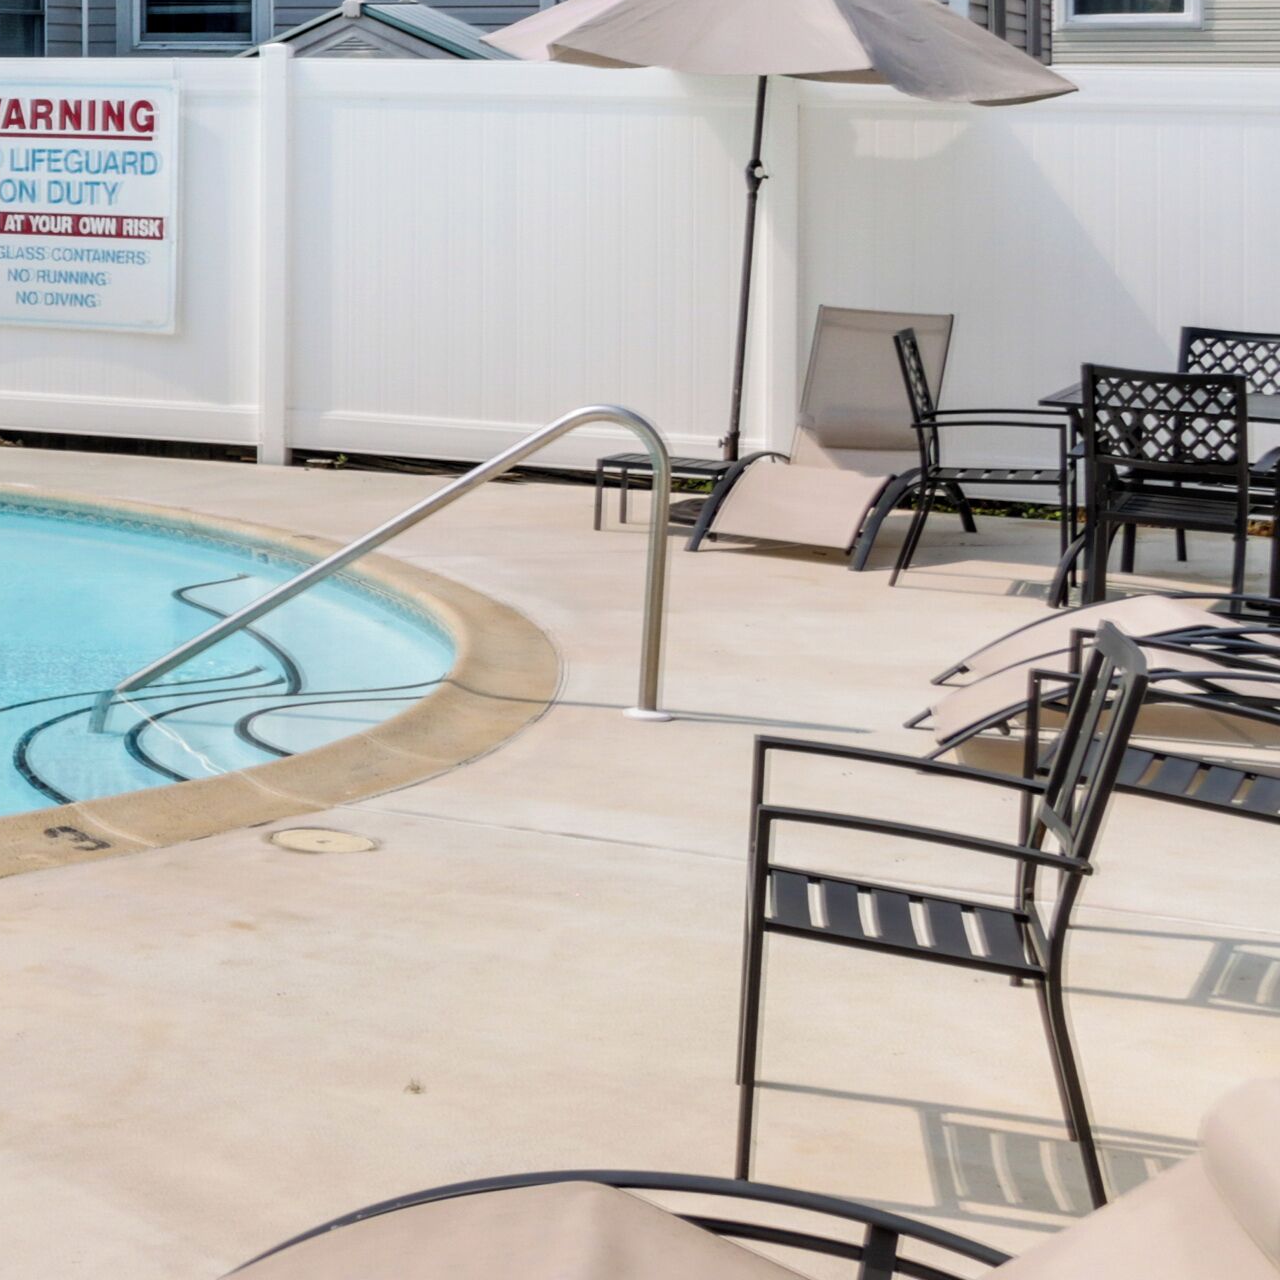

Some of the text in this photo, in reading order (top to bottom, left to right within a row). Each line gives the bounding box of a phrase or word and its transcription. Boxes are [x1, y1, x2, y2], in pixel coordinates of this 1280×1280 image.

[9, 148, 158, 175] LIFEGUARD
[47, 180, 120, 205] DUTY
[4, 214, 25, 232] AT
[28, 215, 72, 234] YOUR
[79, 217, 116, 236] OWN
[122, 218, 161, 238] RISK
[51, 247, 147, 266] CONTAINERS
[7, 269, 108, 286] NO RUNNING
[16, 291, 97, 308] NO DIVING
